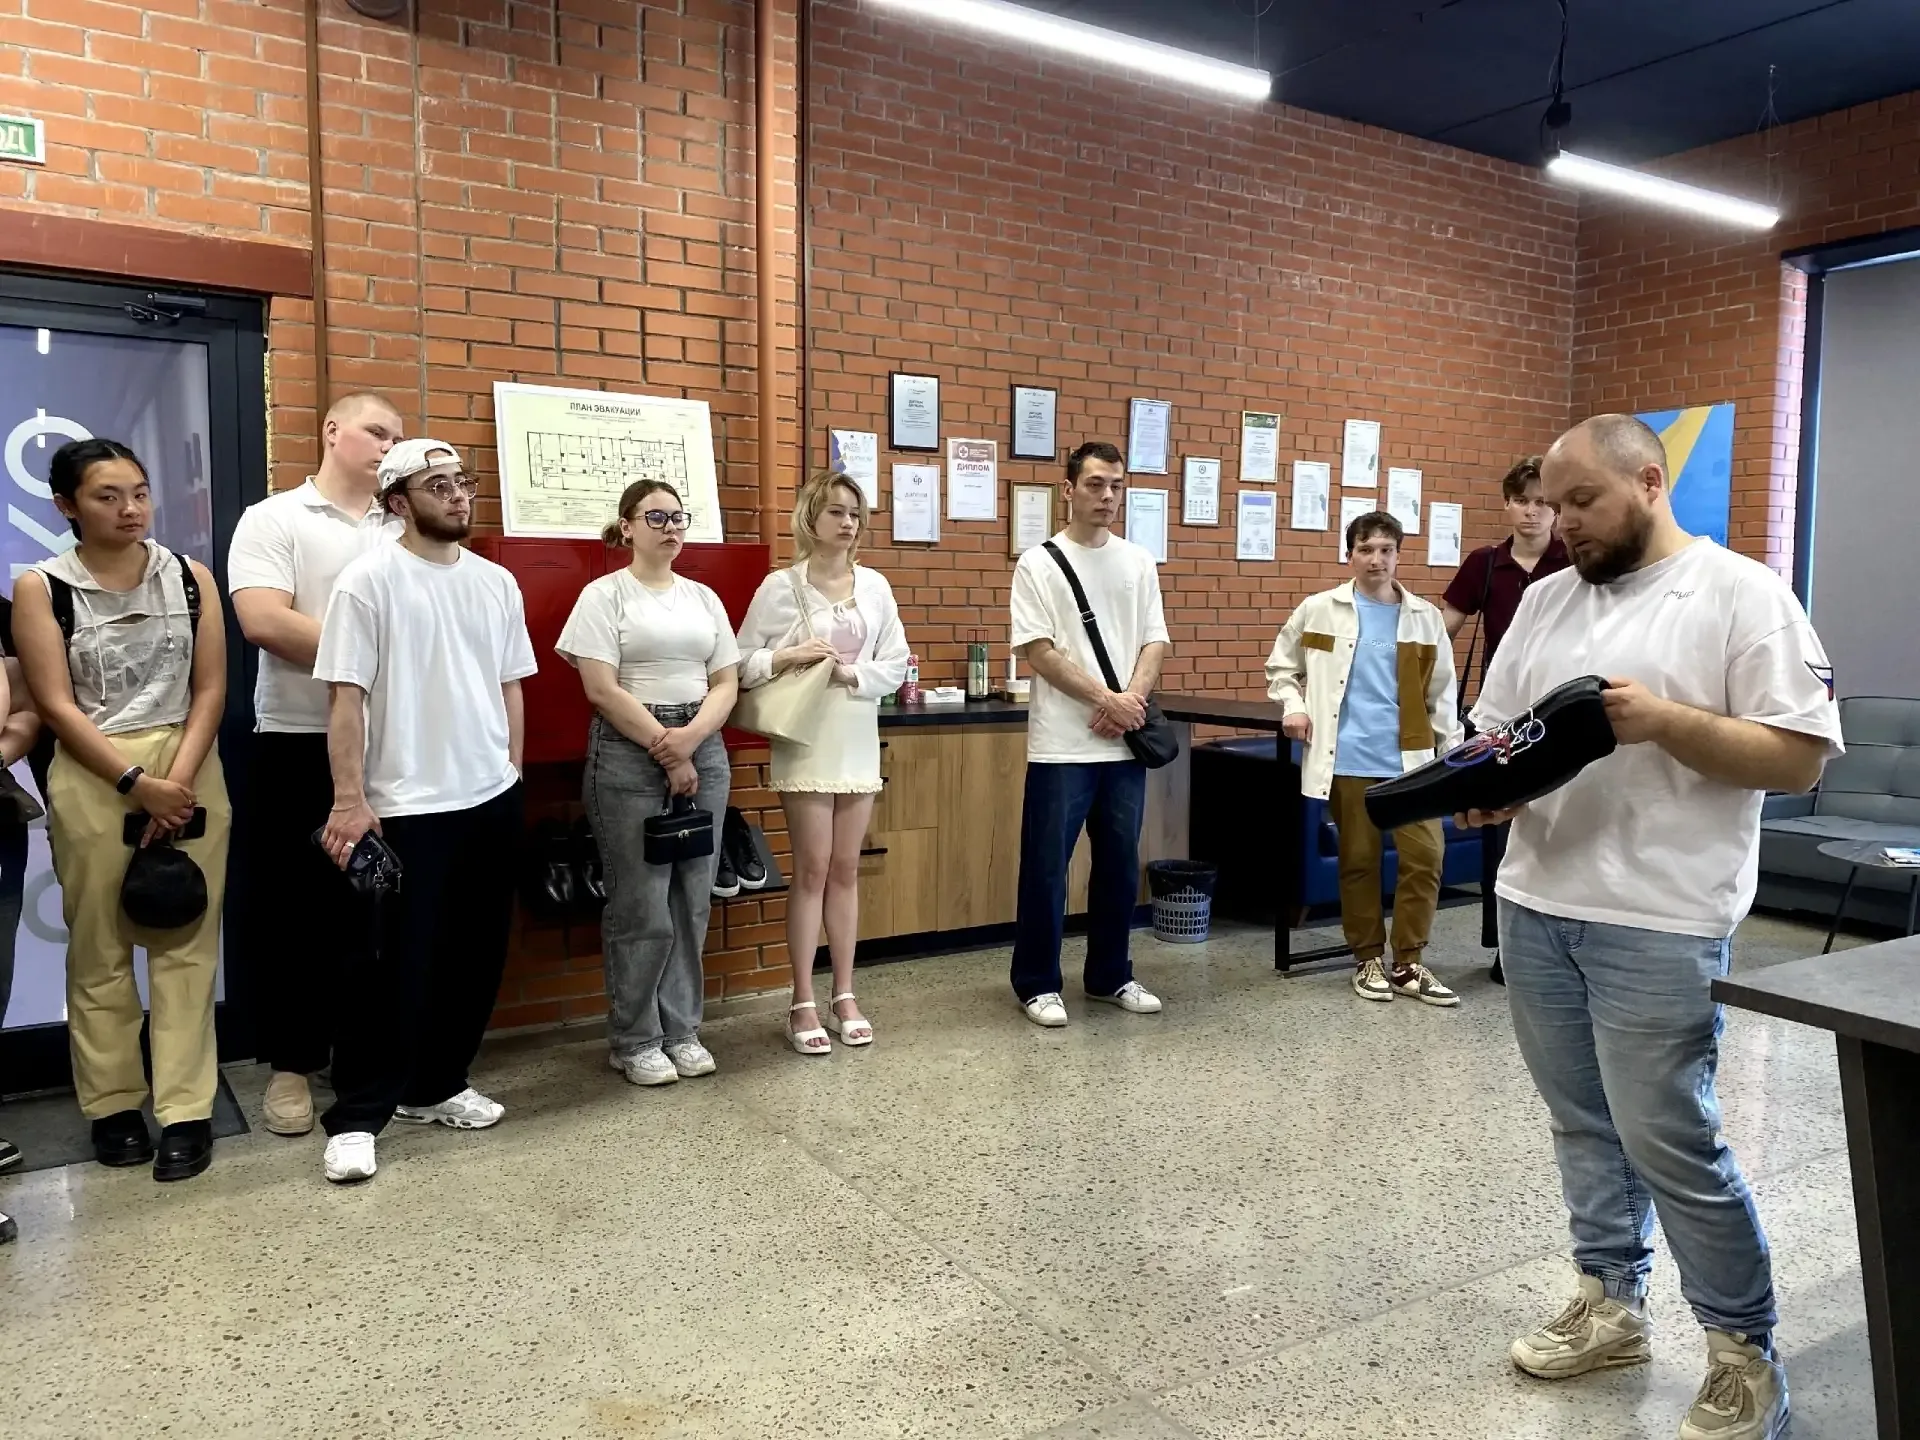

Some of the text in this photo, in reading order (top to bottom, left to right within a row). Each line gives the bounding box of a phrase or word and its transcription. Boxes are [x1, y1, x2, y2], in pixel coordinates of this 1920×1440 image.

[569, 402, 641, 416] ПЛАН ЭВАКУАЦИИ
[956, 463, 990, 472] ДИПЛОМ
